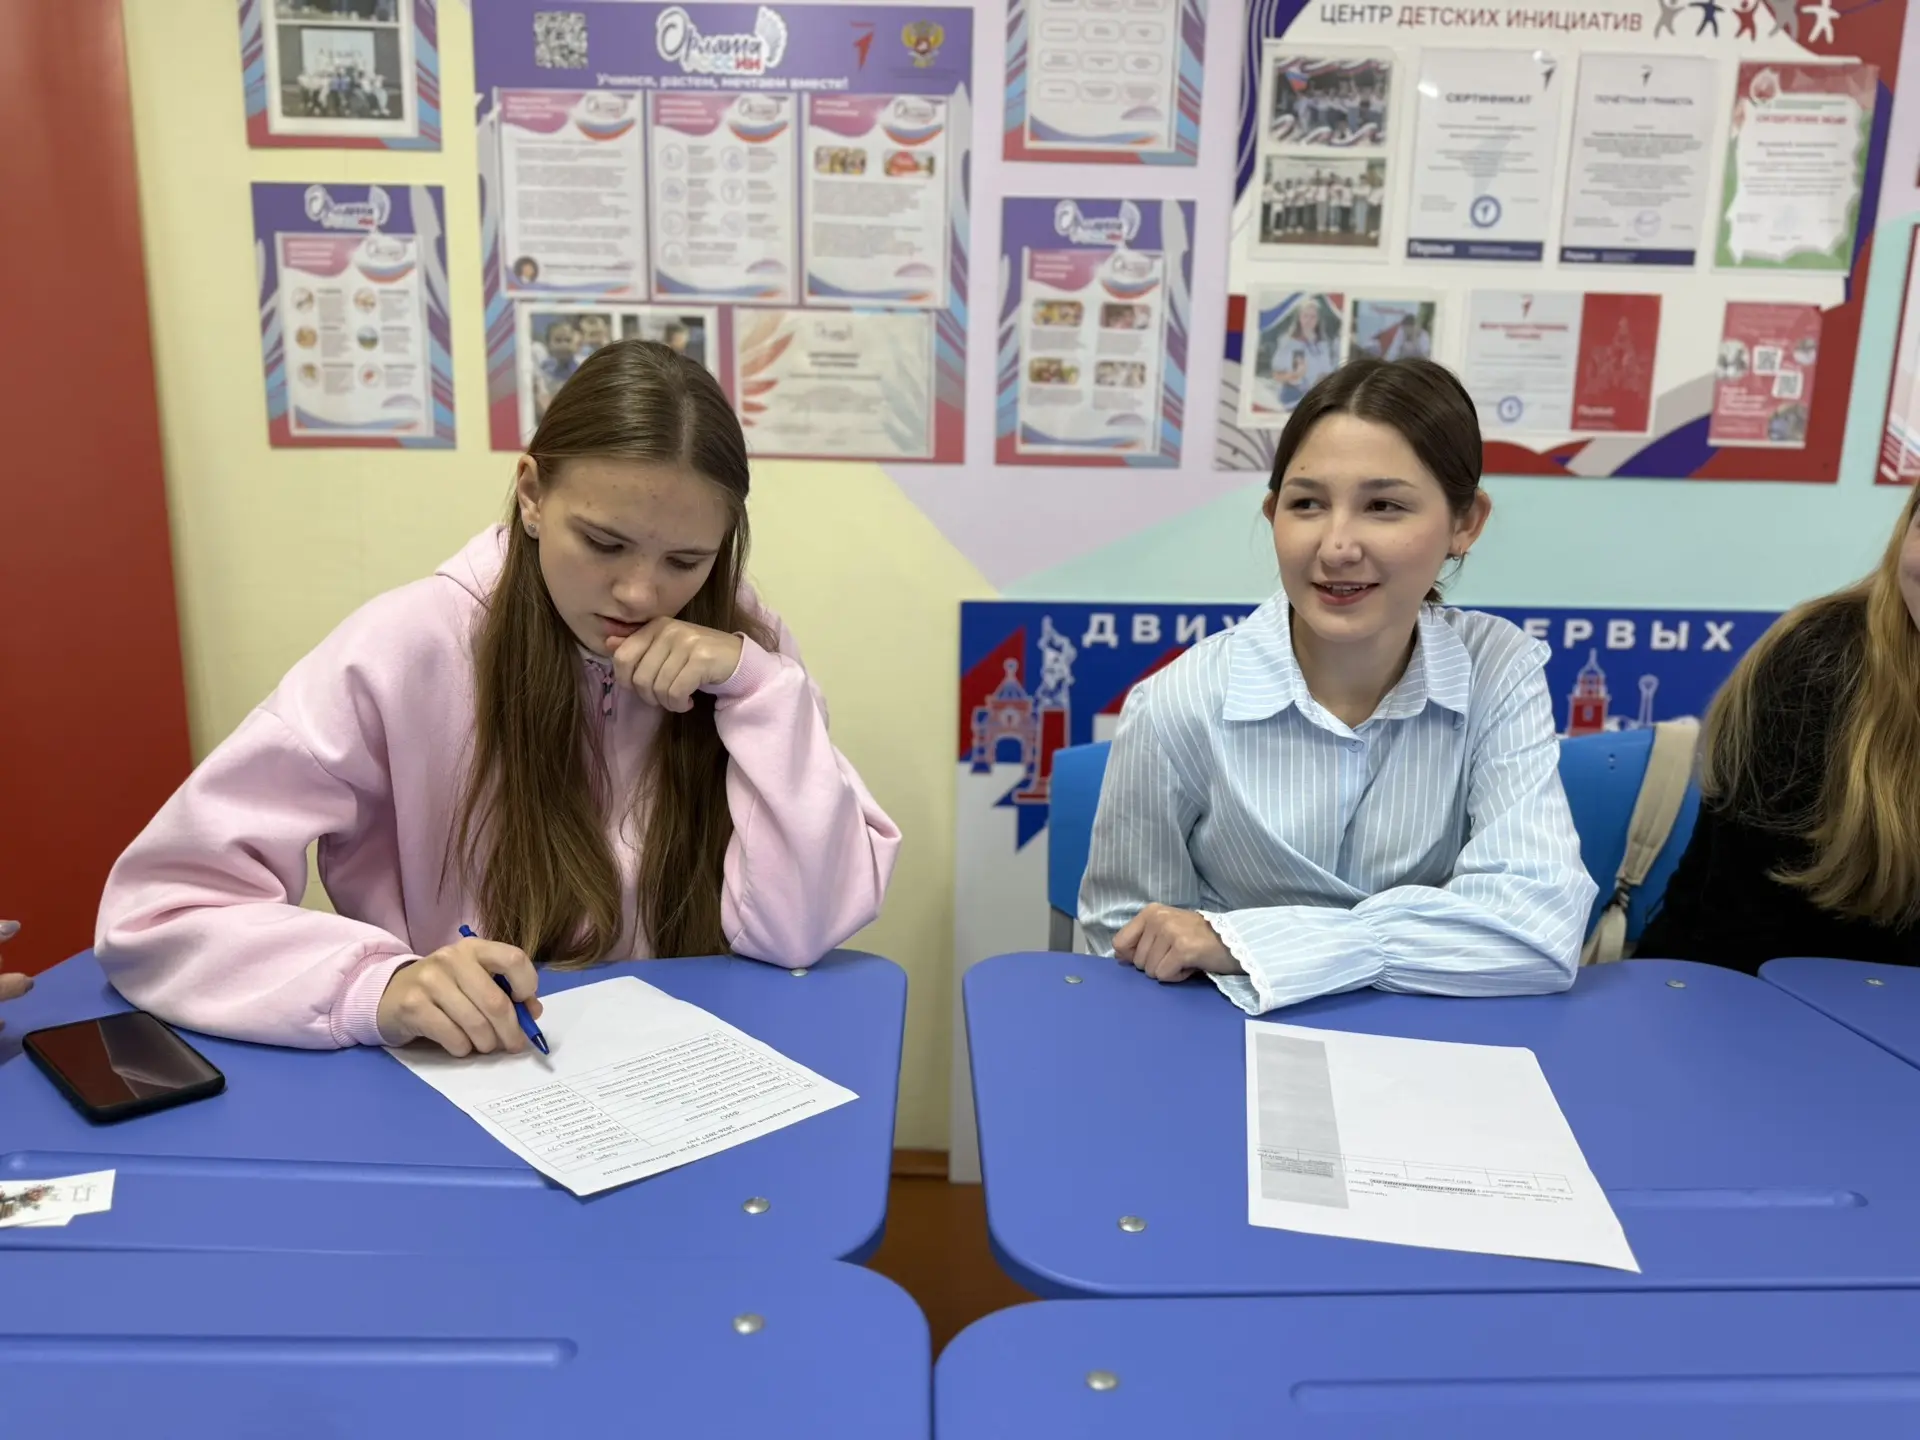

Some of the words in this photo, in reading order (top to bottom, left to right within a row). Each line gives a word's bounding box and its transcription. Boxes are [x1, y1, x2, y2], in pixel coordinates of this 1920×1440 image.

[1320, 4, 1392, 26] ЦЕНТР
[1397, 6, 1499, 28] ДЕТСКИХ
[1506, 11, 1643, 32] ИНИЦИАТИВ
[1445, 92, 1532, 105] СЕРТИФИКАТ
[1522, 618, 1736, 651] ЕРВЫХ
[719, 1110, 739, 1119] ФИО
[594, 1152, 618, 1160] Адрес
